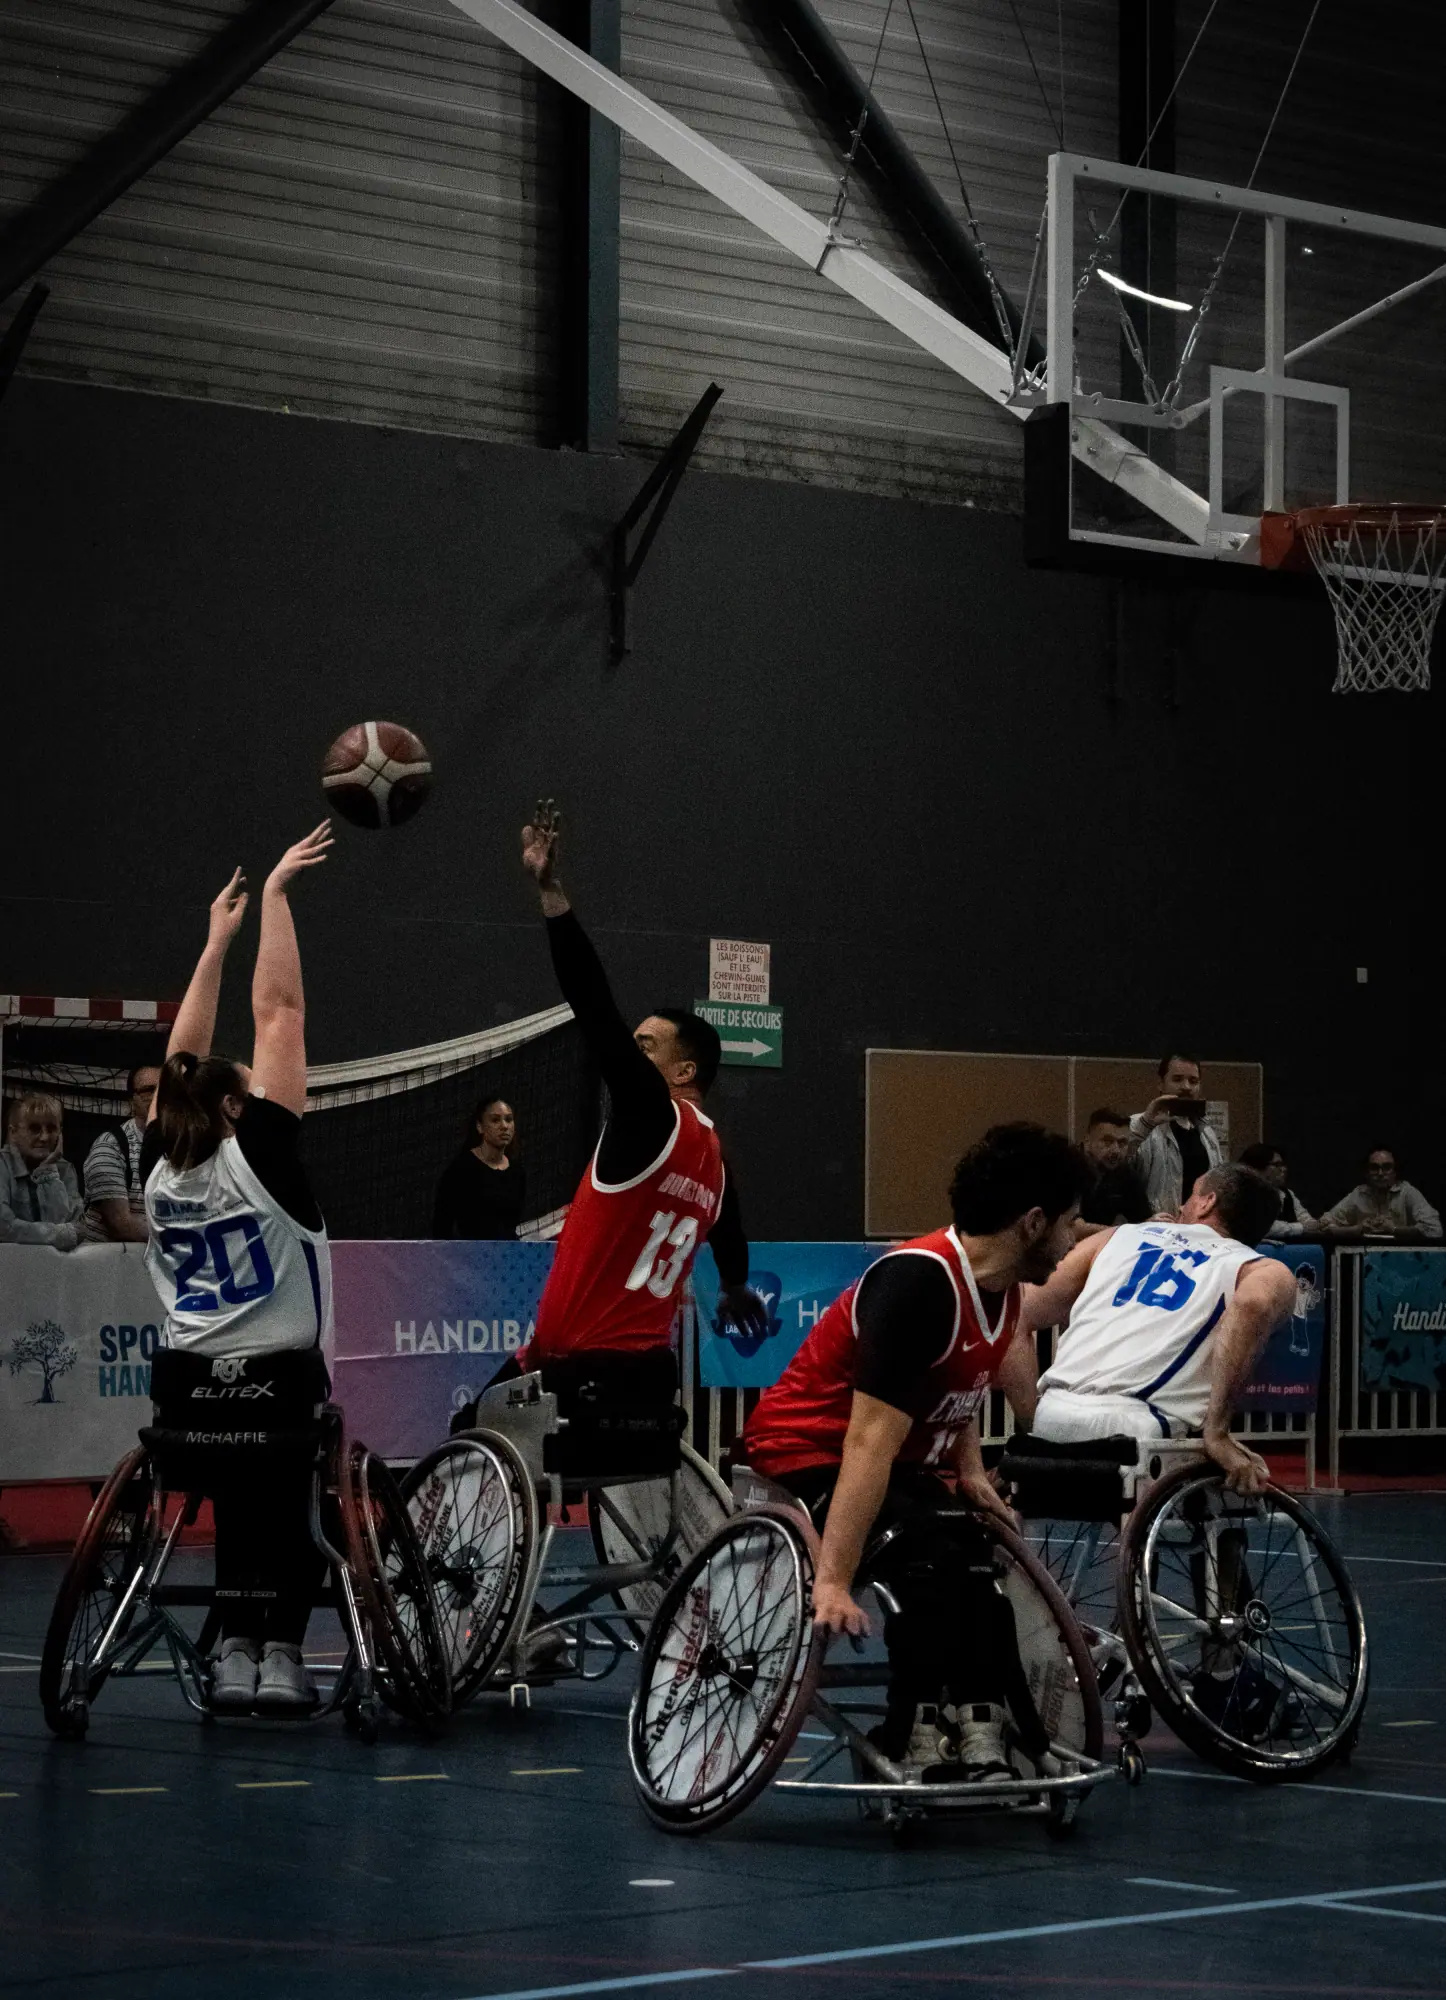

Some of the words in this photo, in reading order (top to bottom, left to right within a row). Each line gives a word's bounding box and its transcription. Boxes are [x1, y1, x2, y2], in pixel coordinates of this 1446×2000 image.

[716, 942, 728, 951] LES
[729, 943, 764, 954] BOISSONS
[729, 963, 738, 972] ET
[739, 964, 751, 973] LES
[713, 971, 766, 984] CHEWIN-GUMS
[712, 980, 731, 991] SONT
[733, 982, 767, 994] INTERDITS
[718, 991, 732, 1001] SUR
[733, 993, 742, 1001] LA
[743, 993, 761, 1003] PISTE
[727, 1008, 740, 1028] DE
[741, 1010, 782, 1030] SECOURS
[624, 1209, 699, 1299] 13
[160, 1215, 275, 1312] 20
[1112, 1242, 1211, 1311] 16
[211, 1358, 248, 1384] RGK
[186, 1431, 267, 1445] McHAFFIE
